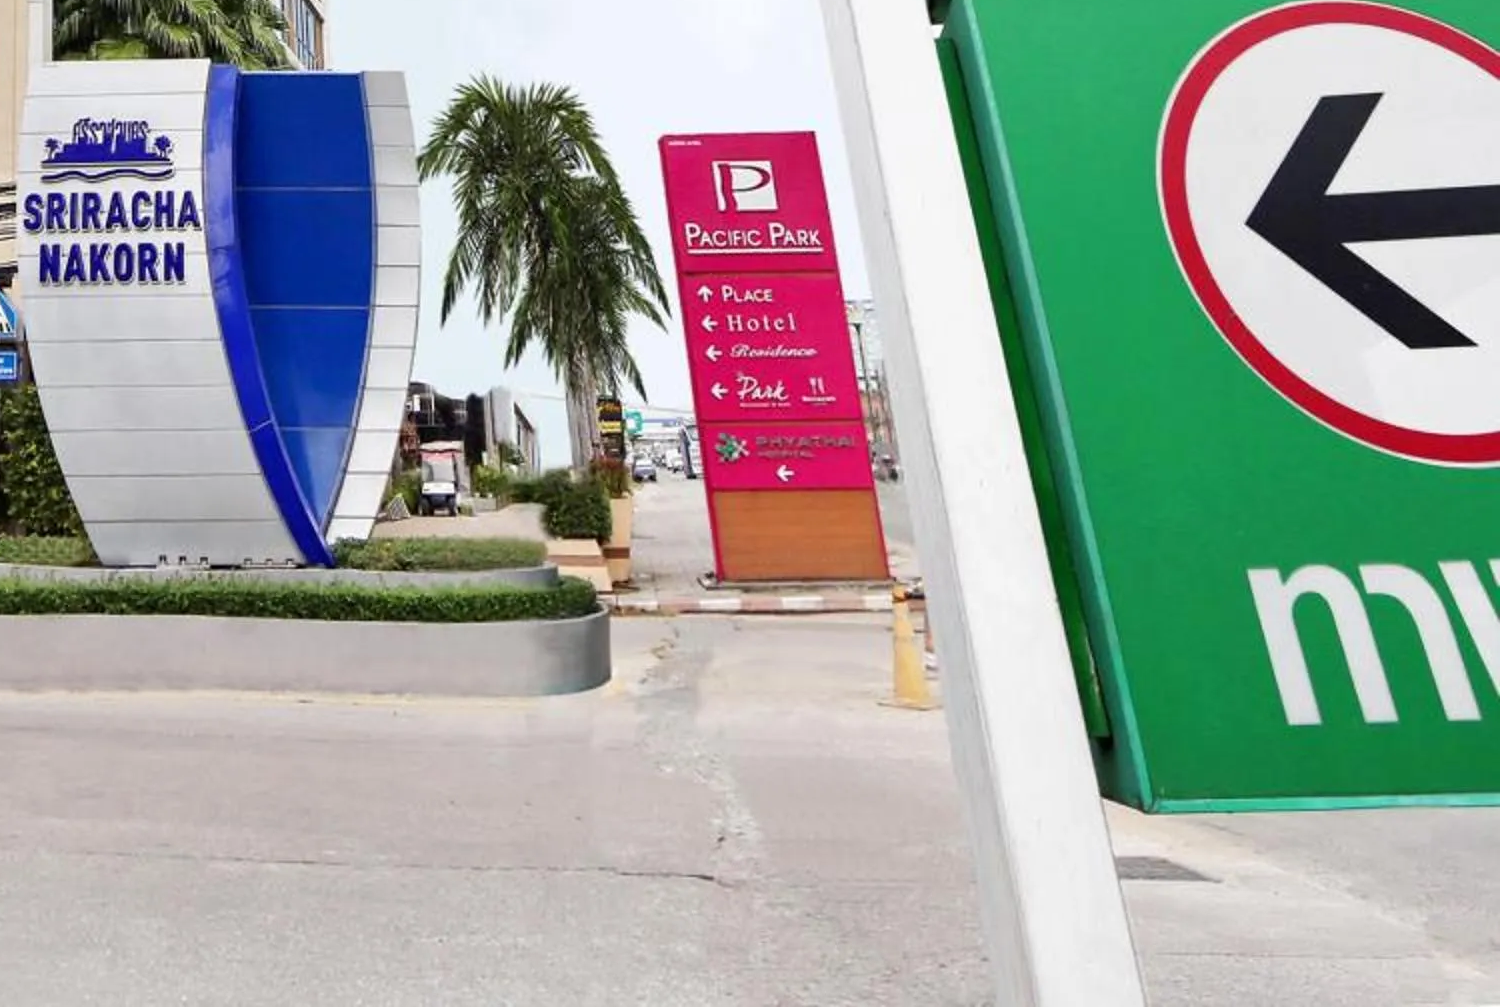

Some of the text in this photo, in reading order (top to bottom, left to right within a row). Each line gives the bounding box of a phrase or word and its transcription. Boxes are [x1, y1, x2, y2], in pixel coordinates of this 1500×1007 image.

[23, 190, 201, 232] SRIRACHA
[39, 242, 186, 284] NAKORN
[726, 312, 797, 332] Hotel
[729, 343, 819, 359] Residence
[736, 375, 789, 401] Park
